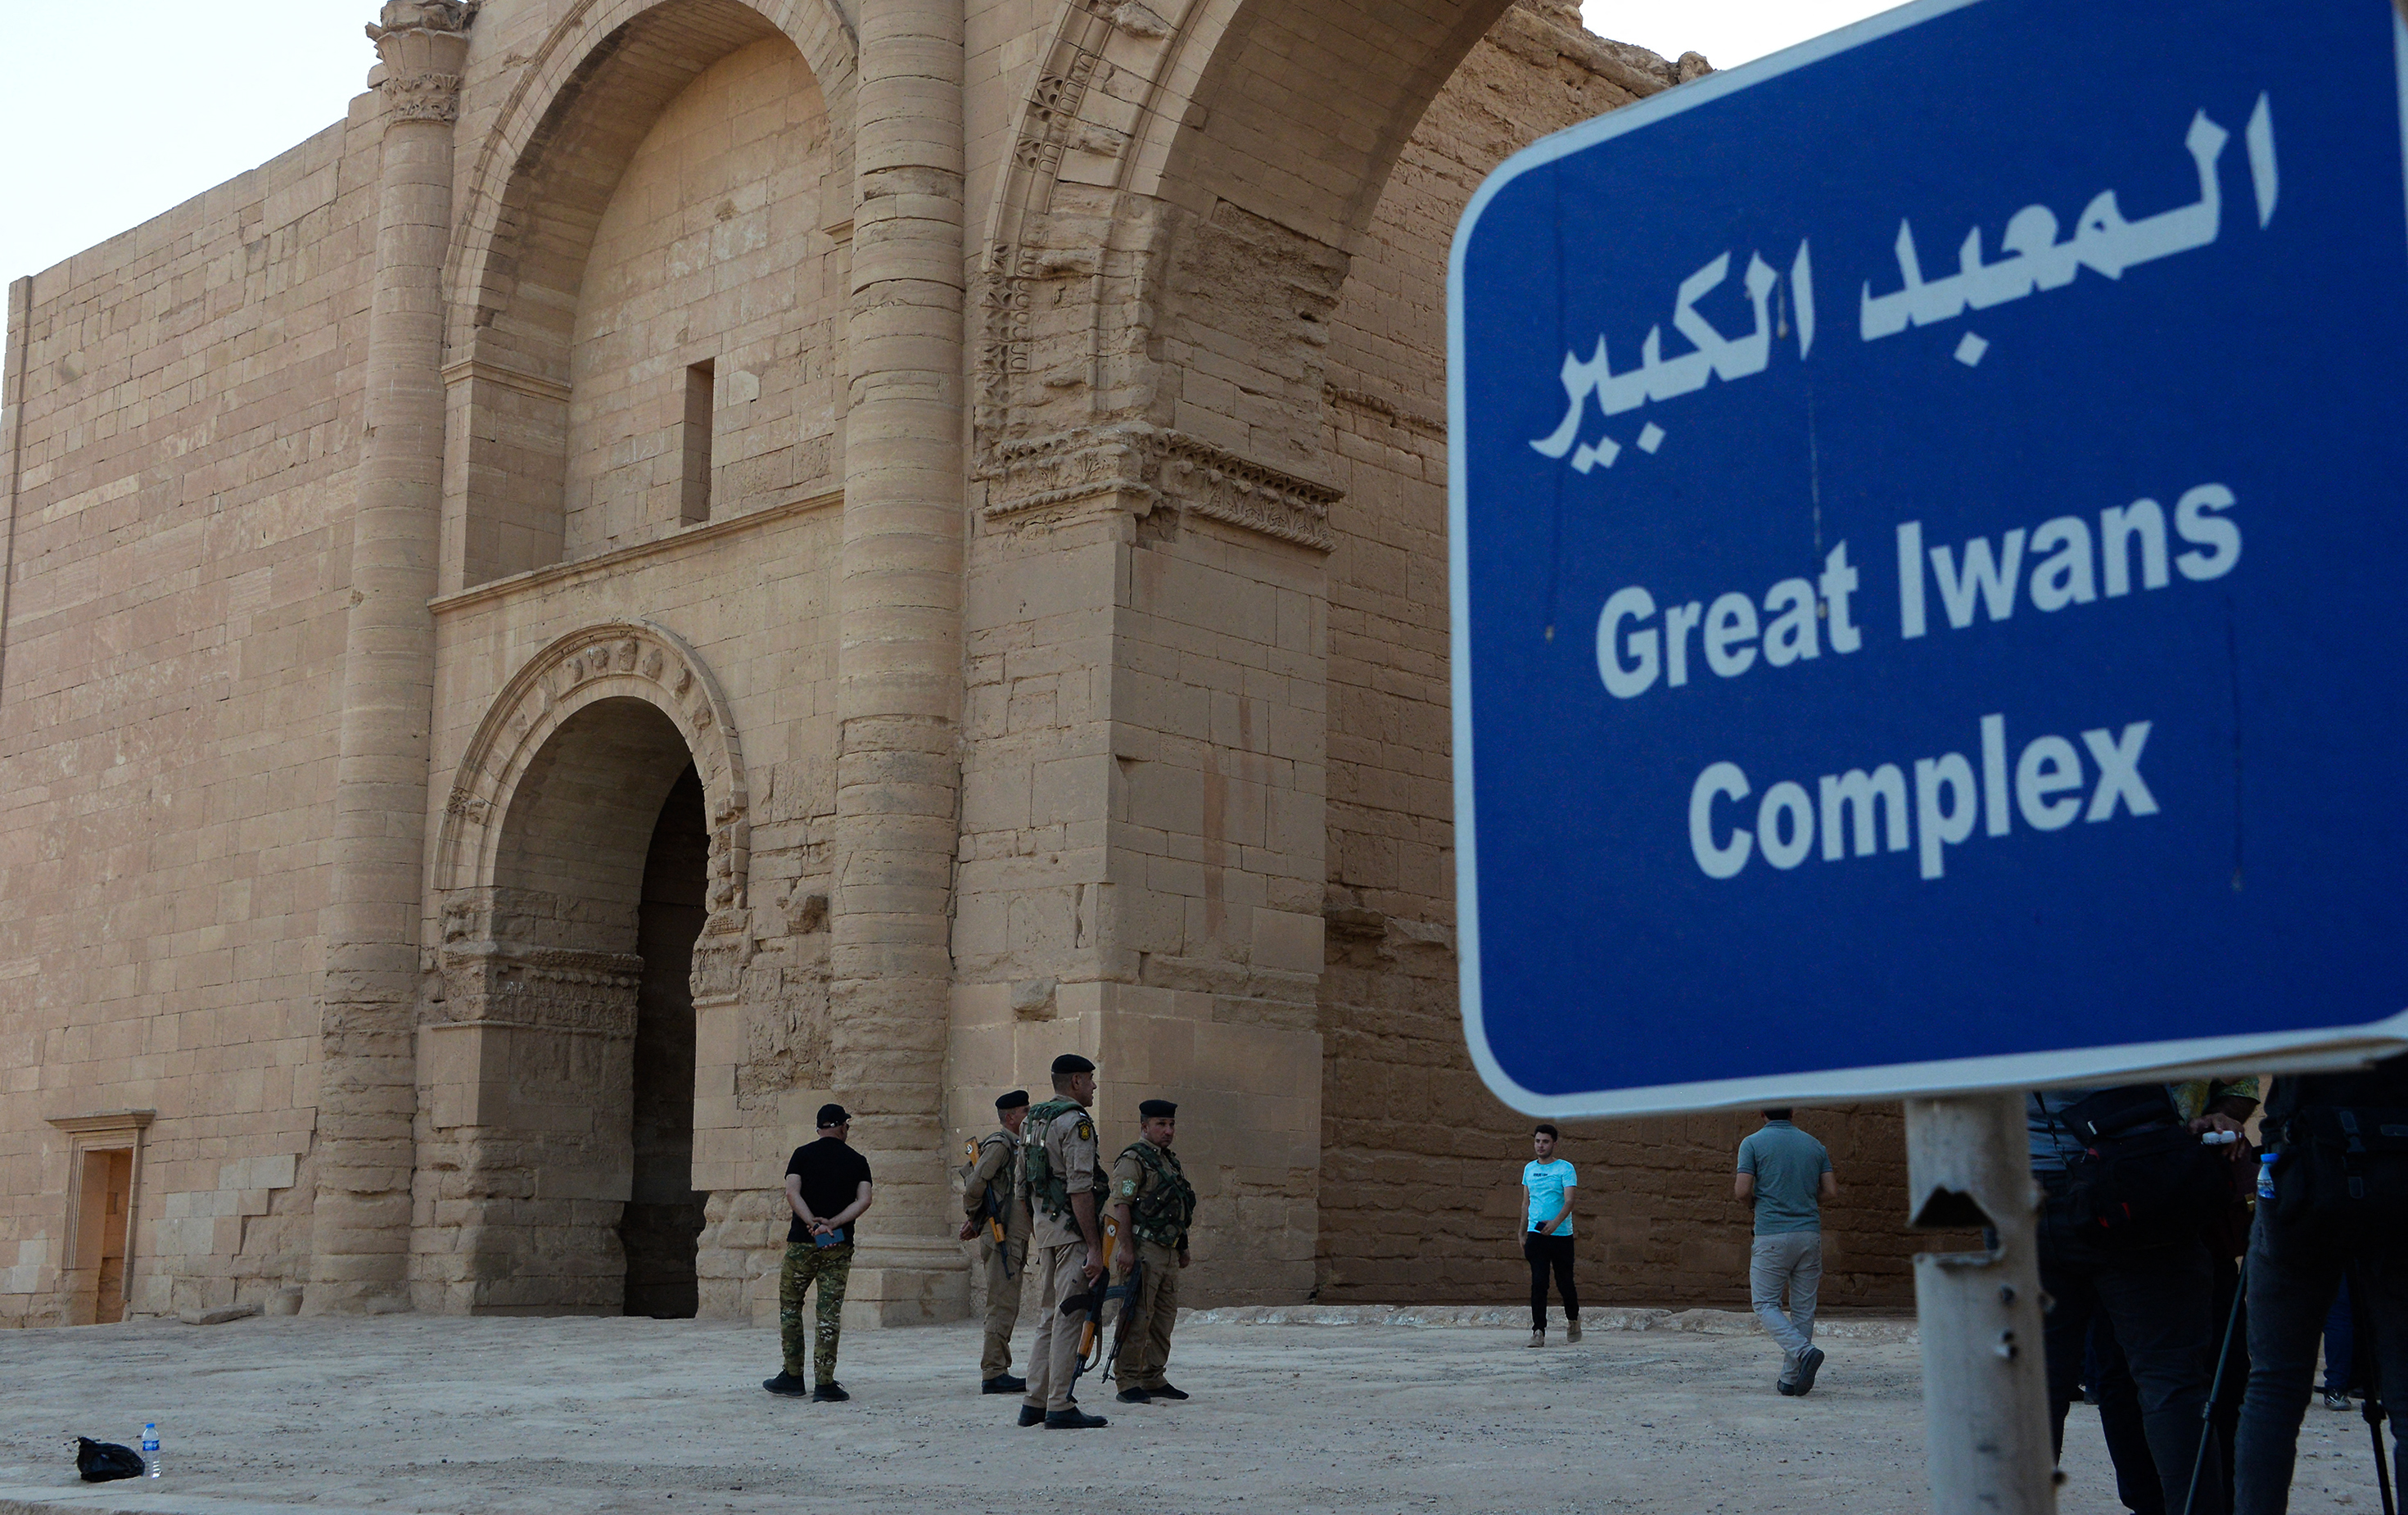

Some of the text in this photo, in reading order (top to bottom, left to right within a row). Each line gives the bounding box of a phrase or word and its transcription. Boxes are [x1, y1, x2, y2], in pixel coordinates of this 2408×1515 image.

[1529, 91, 2279, 473] المعبد الكبير
[1597, 484, 2242, 699] Great Iwans
[1689, 715, 2159, 880] Complex
